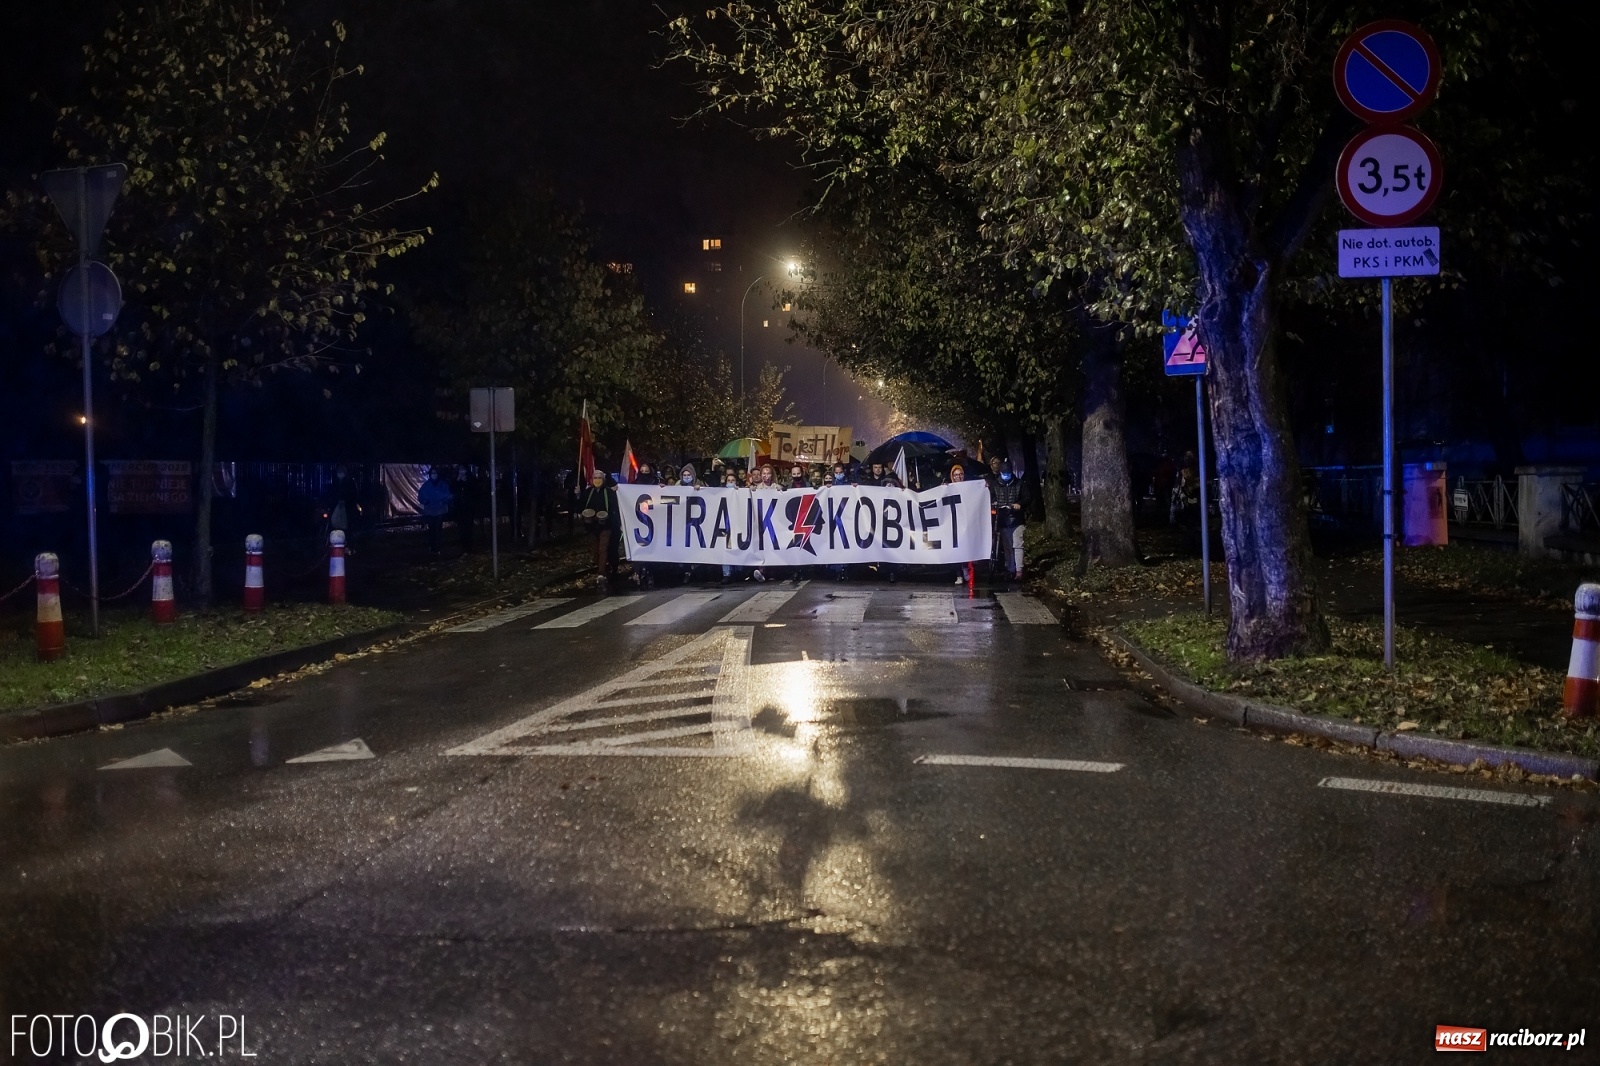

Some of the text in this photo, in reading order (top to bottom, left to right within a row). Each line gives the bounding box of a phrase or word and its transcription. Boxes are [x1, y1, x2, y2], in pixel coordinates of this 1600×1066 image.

[1358, 157, 1426, 197] 3,5t
[1342, 235, 1436, 249] Nie dot. autob.
[1353, 256, 1380, 268] PKS
[1394, 255, 1424, 267] PKM
[634, 493, 962, 551] STRAJK KOBIET
